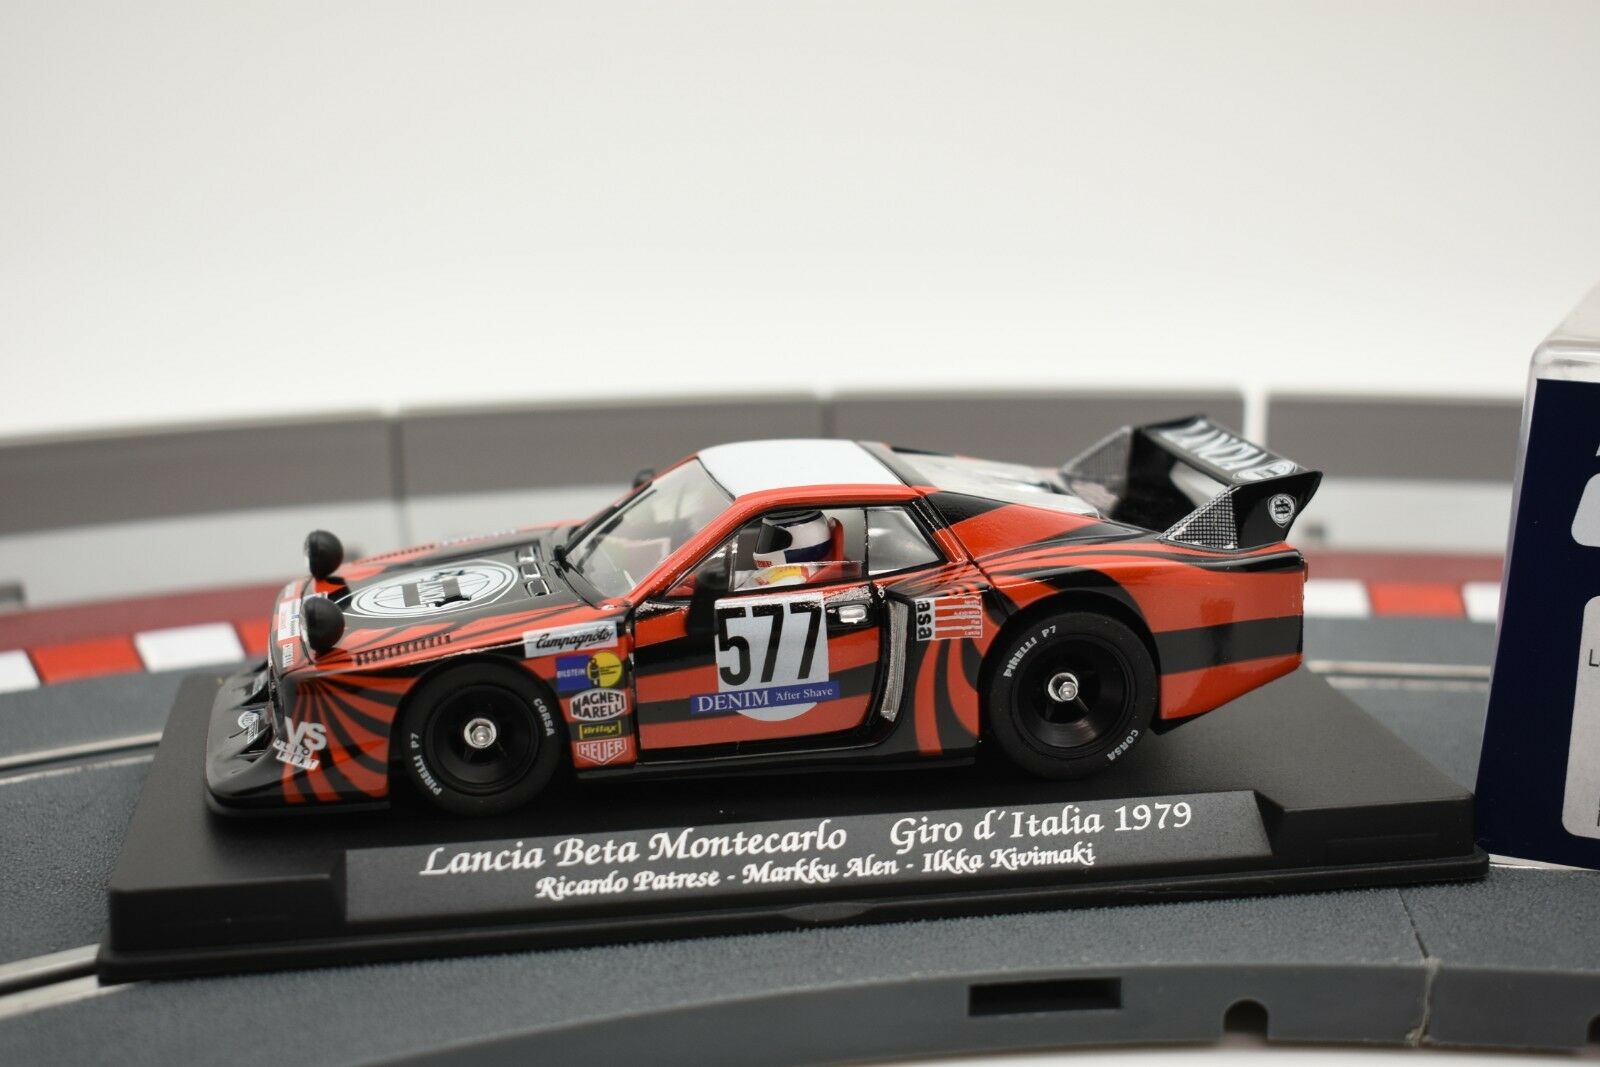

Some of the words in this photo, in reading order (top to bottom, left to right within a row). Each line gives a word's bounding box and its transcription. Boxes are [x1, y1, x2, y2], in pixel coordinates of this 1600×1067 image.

[535, 624, 613, 650] Campagnolo
[917, 600, 932, 640] asa
[718, 603, 822, 686] 577
[1003, 636, 1037, 678] PIRELLI
[1042, 624, 1057, 638] P7
[533, 698, 555, 737] CORSA
[572, 691, 625, 710] MAGNETI
[573, 702, 625, 719] MARELLI
[697, 690, 770, 713] DENIM
[775, 690, 801, 702] After
[803, 686, 833, 698] Shave
[285, 715, 327, 751] VS
[410, 732, 420, 749] P7
[580, 740, 624, 762] HEUER
[1106, 729, 1139, 761] CORSA
[413, 754, 443, 796] PIRELLI
[419, 840, 546, 877] Lancia
[554, 838, 639, 867] Beta
[648, 819, 847, 861] Montecarlo
[890, 817, 963, 853] Giro
[1114, 802, 1192, 832] 1979
[535, 870, 628, 902] Ricardo
[633, 869, 720, 893] Patrese
[742, 857, 838, 885] Markku
[843, 853, 899, 878] Alen
[922, 848, 984, 875] Ilkka
[990, 841, 1097, 871] Kivimaki
